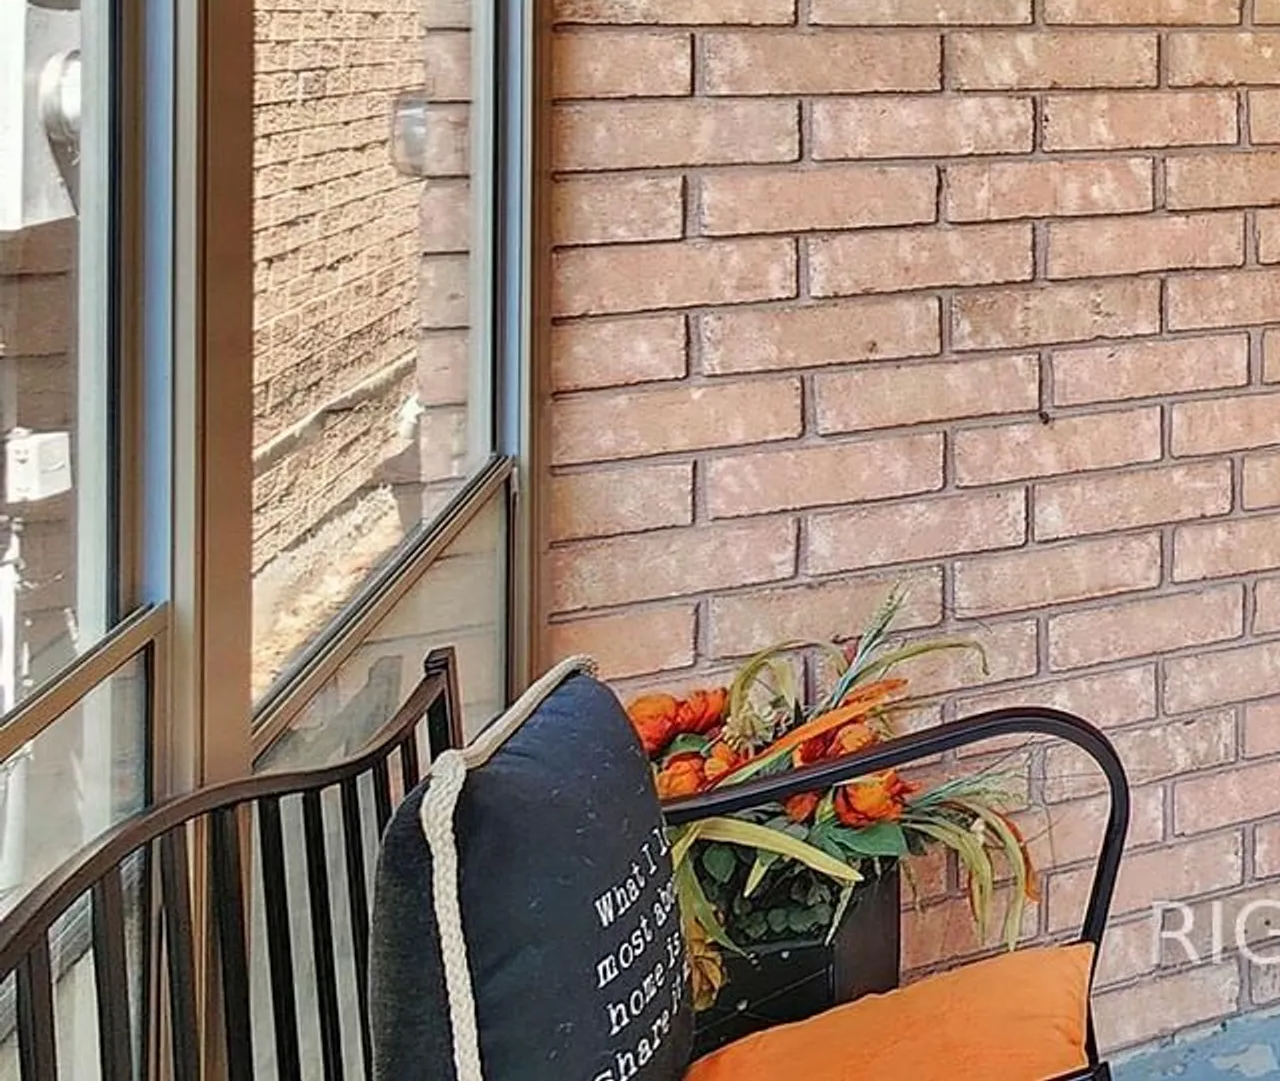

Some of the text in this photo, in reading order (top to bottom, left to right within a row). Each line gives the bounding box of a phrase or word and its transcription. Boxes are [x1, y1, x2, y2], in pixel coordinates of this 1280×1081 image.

[594, 862, 646, 928] What
[596, 914, 653, 989] most
[605, 962, 665, 1036] home
